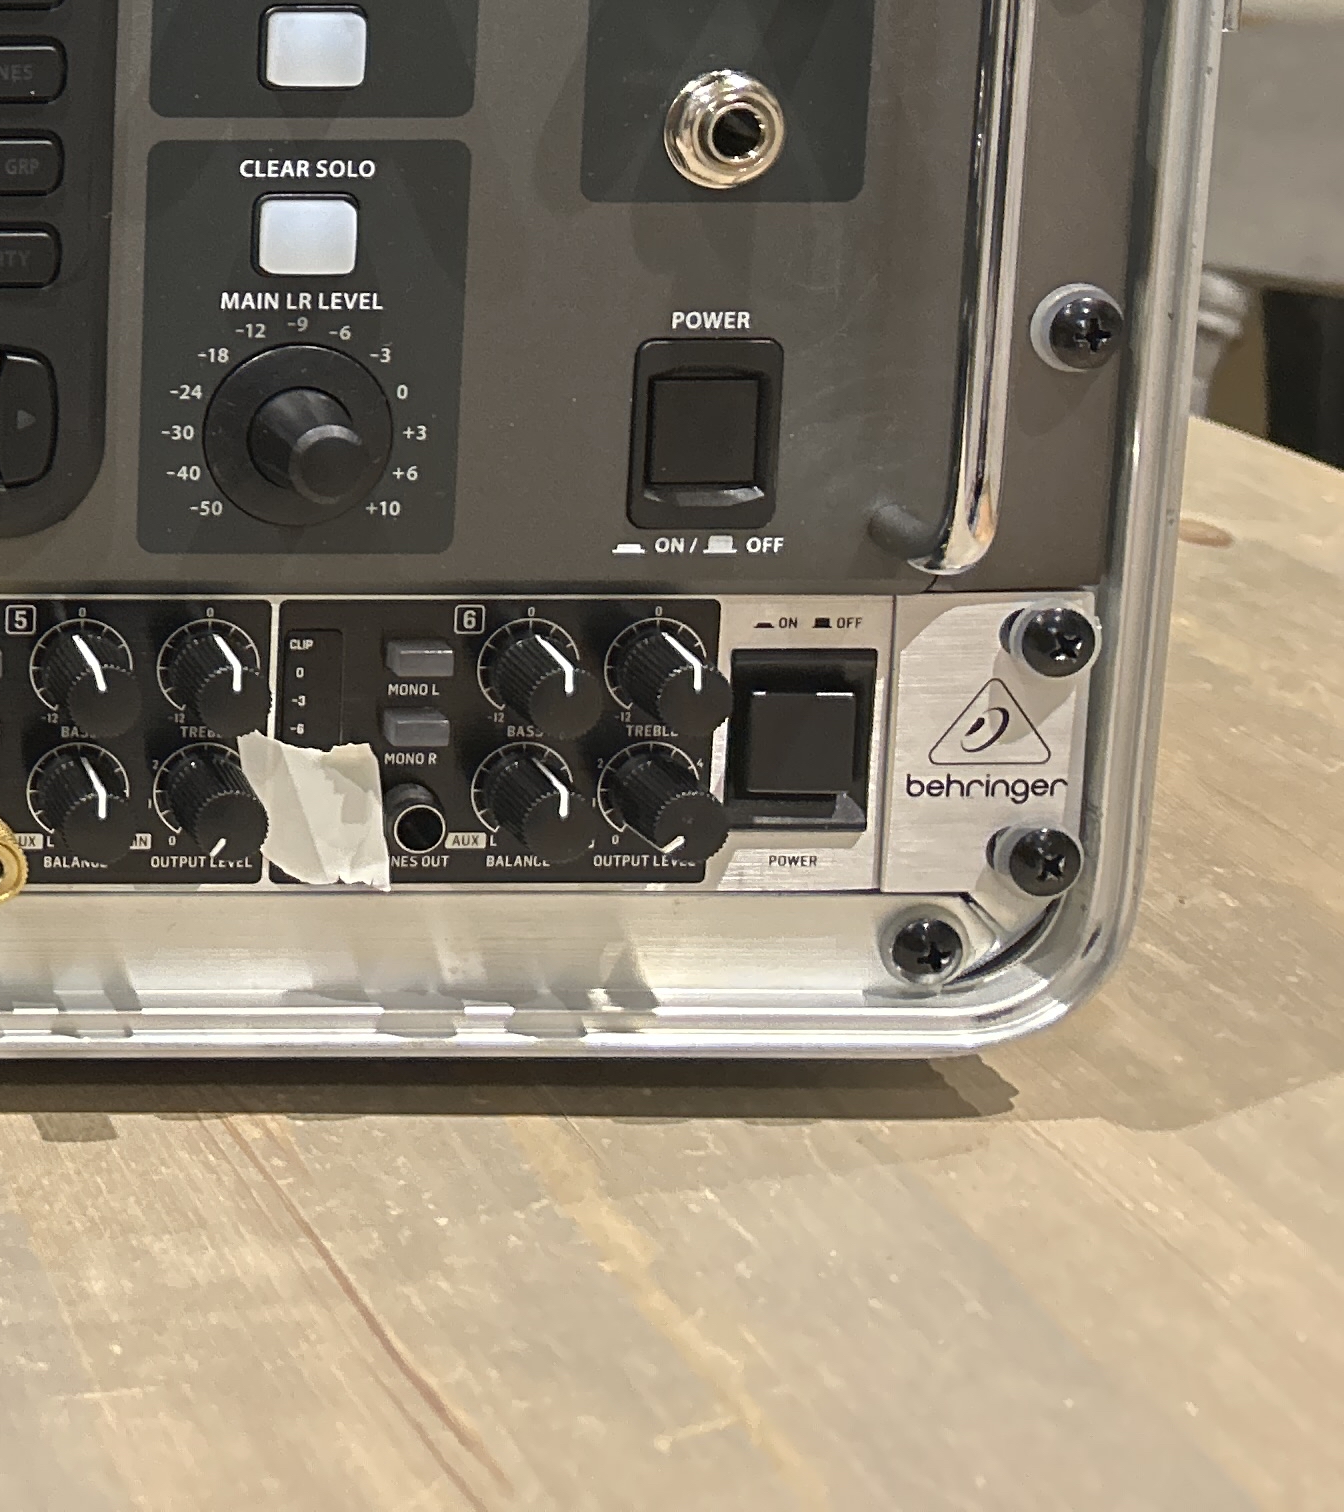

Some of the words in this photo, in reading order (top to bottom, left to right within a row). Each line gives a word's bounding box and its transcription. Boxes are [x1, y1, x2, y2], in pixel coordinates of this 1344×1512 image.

[5, 159, 40, 175] GRP
[240, 160, 309, 177] CLEAR
[316, 160, 375, 177] SOLO
[221, 292, 278, 309] MAIN
[287, 293, 311, 309] LR
[319, 293, 383, 309] LEVEL
[288, 317, 308, 331] -9
[672, 312, 749, 329] POWER
[236, 324, 265, 338] -12
[329, 326, 351, 340] -6
[198, 348, 228, 363] -18
[370, 348, 390, 362] -3
[170, 385, 202, 399] -24
[397, 385, 408, 399] 0
[162, 425, 194, 440] -30
[403, 426, 426, 440] +3
[167, 466, 200, 480] -40
[393, 466, 418, 480] +6
[190, 501, 222, 515] -50
[366, 501, 400, 515] +10
[655, 538, 684, 552] ON
[746, 537, 783, 552] OFF
[15, 610, 26, 629] 5
[464, 610, 476, 629] 6
[779, 617, 797, 628] ON
[837, 617, 862, 628] OFF
[388, 684, 428, 695] MONO
[432, 684, 439, 695] L
[906, 774, 1068, 804] behringer
[452, 835, 479, 847] AUX
[151, 856, 206, 867] OUTPUT
[422, 856, 449, 867] OUT
[769, 855, 817, 867] POWER
